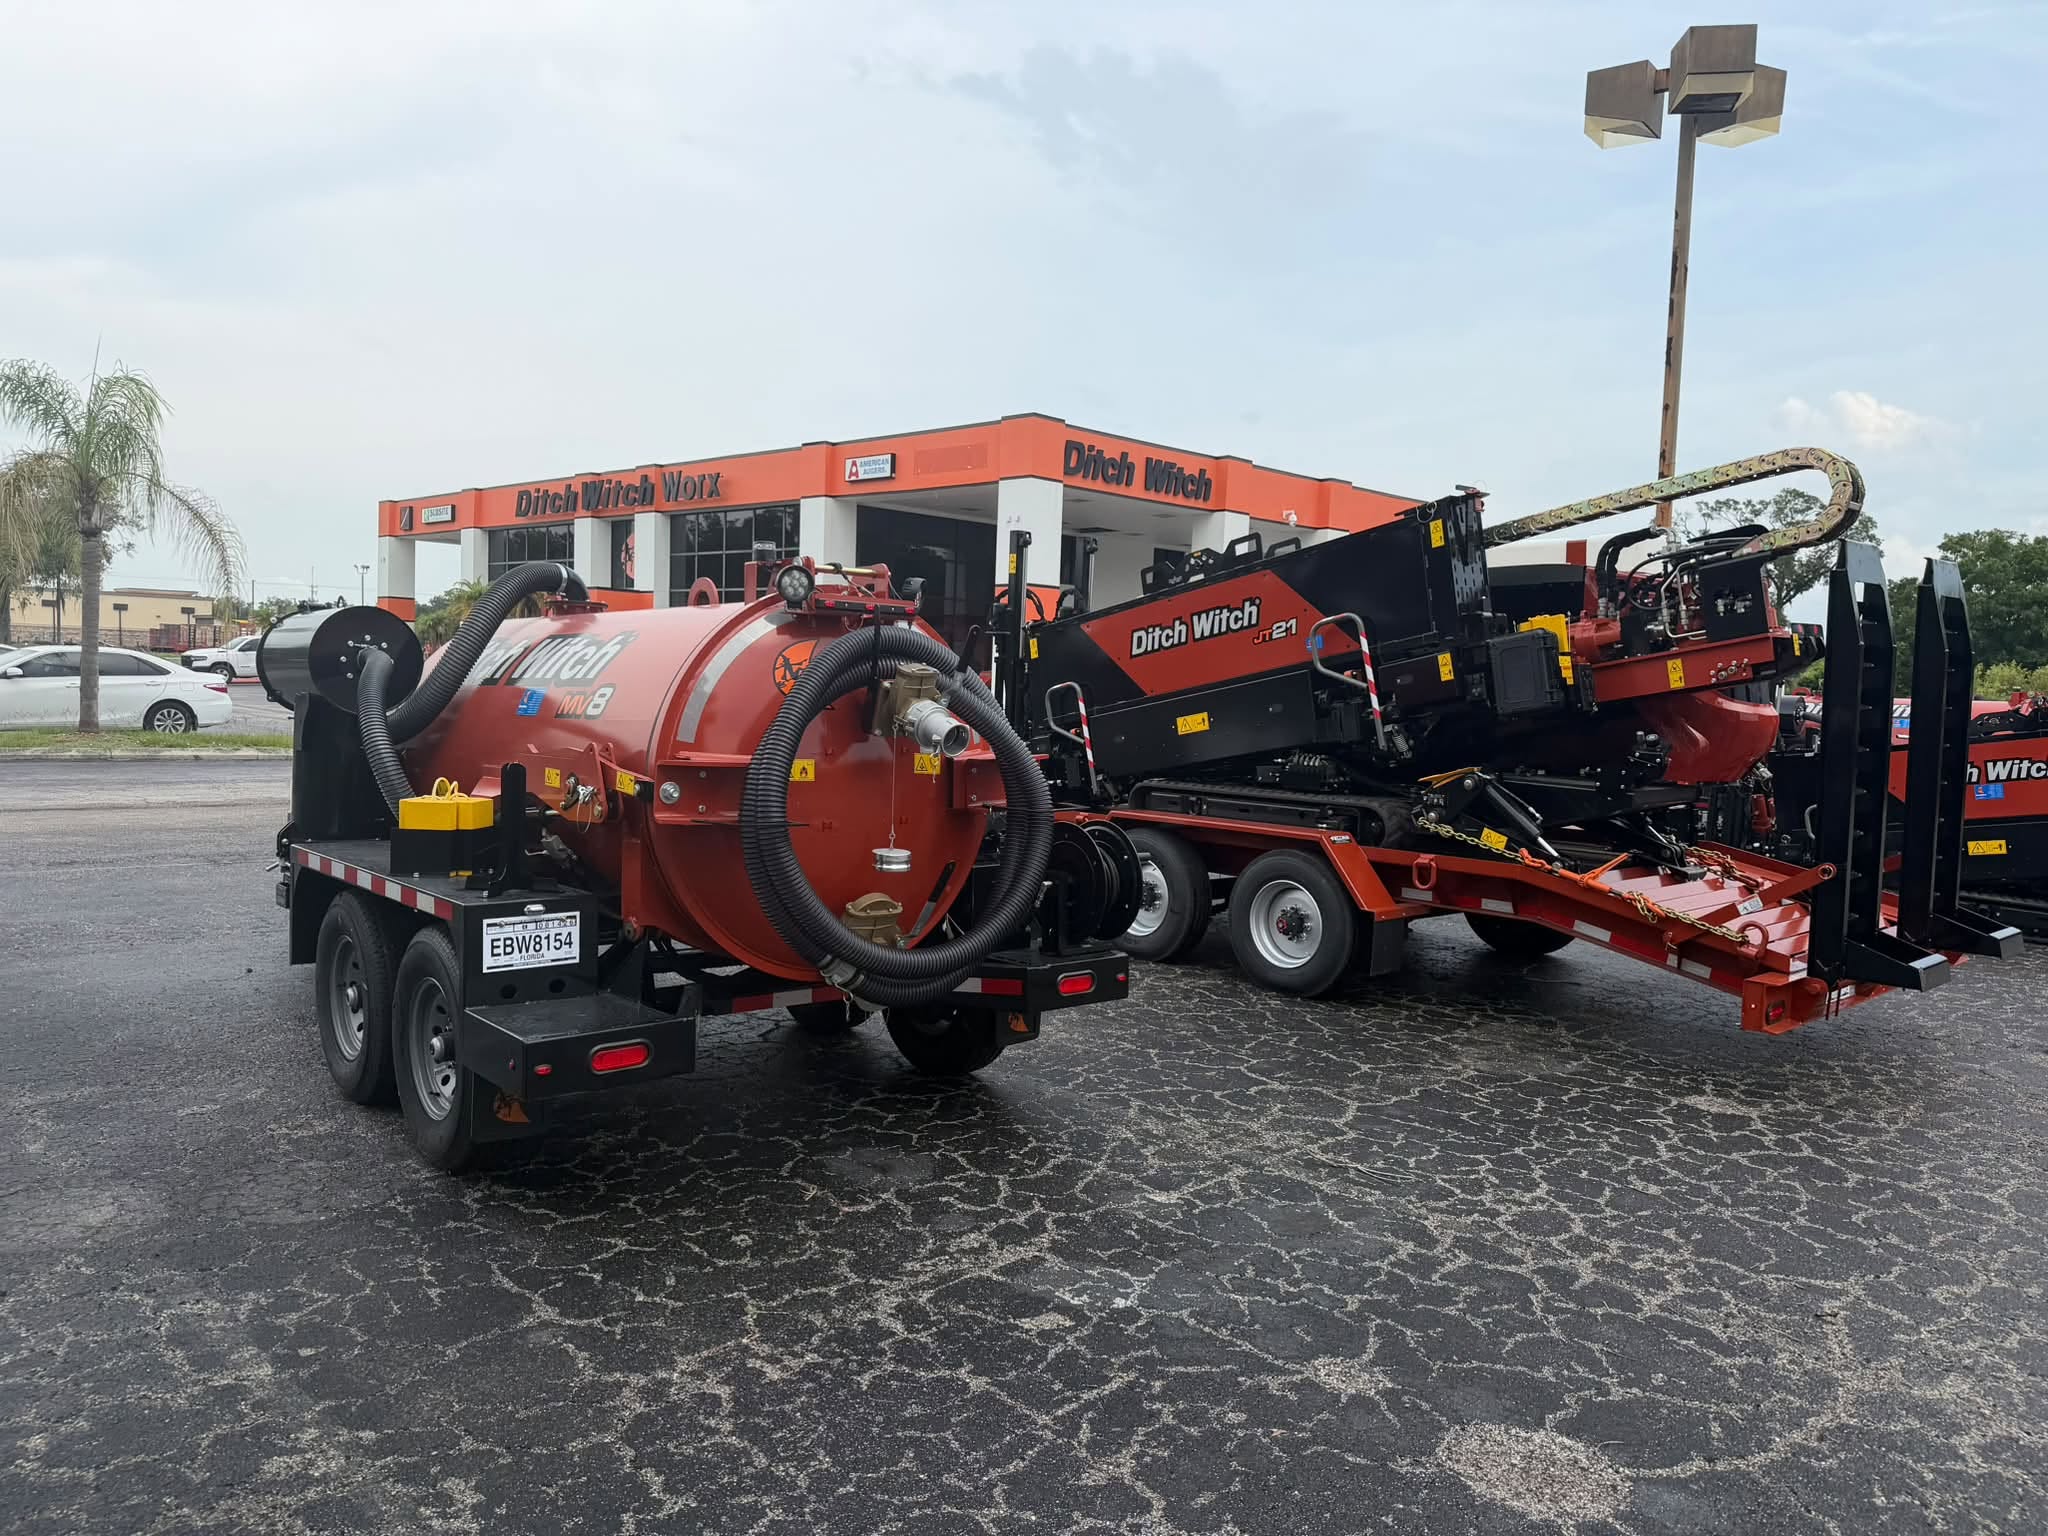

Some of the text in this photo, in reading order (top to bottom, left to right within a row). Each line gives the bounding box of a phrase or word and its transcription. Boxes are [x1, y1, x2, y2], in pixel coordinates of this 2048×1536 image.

[1063, 439, 1213, 500] Ditch Witch
[515, 471, 721, 517] Ditch Witch Worx
[1131, 600, 1259, 657] Ditch Witch
[1254, 618, 1297, 645] JT21
[510, 634, 626, 681] Witch
[557, 686, 616, 716] MV8
[1986, 759, 2048, 781] Witc
[490, 931, 574, 957] EBW8154
[520, 952, 545, 961] FLORIDA
